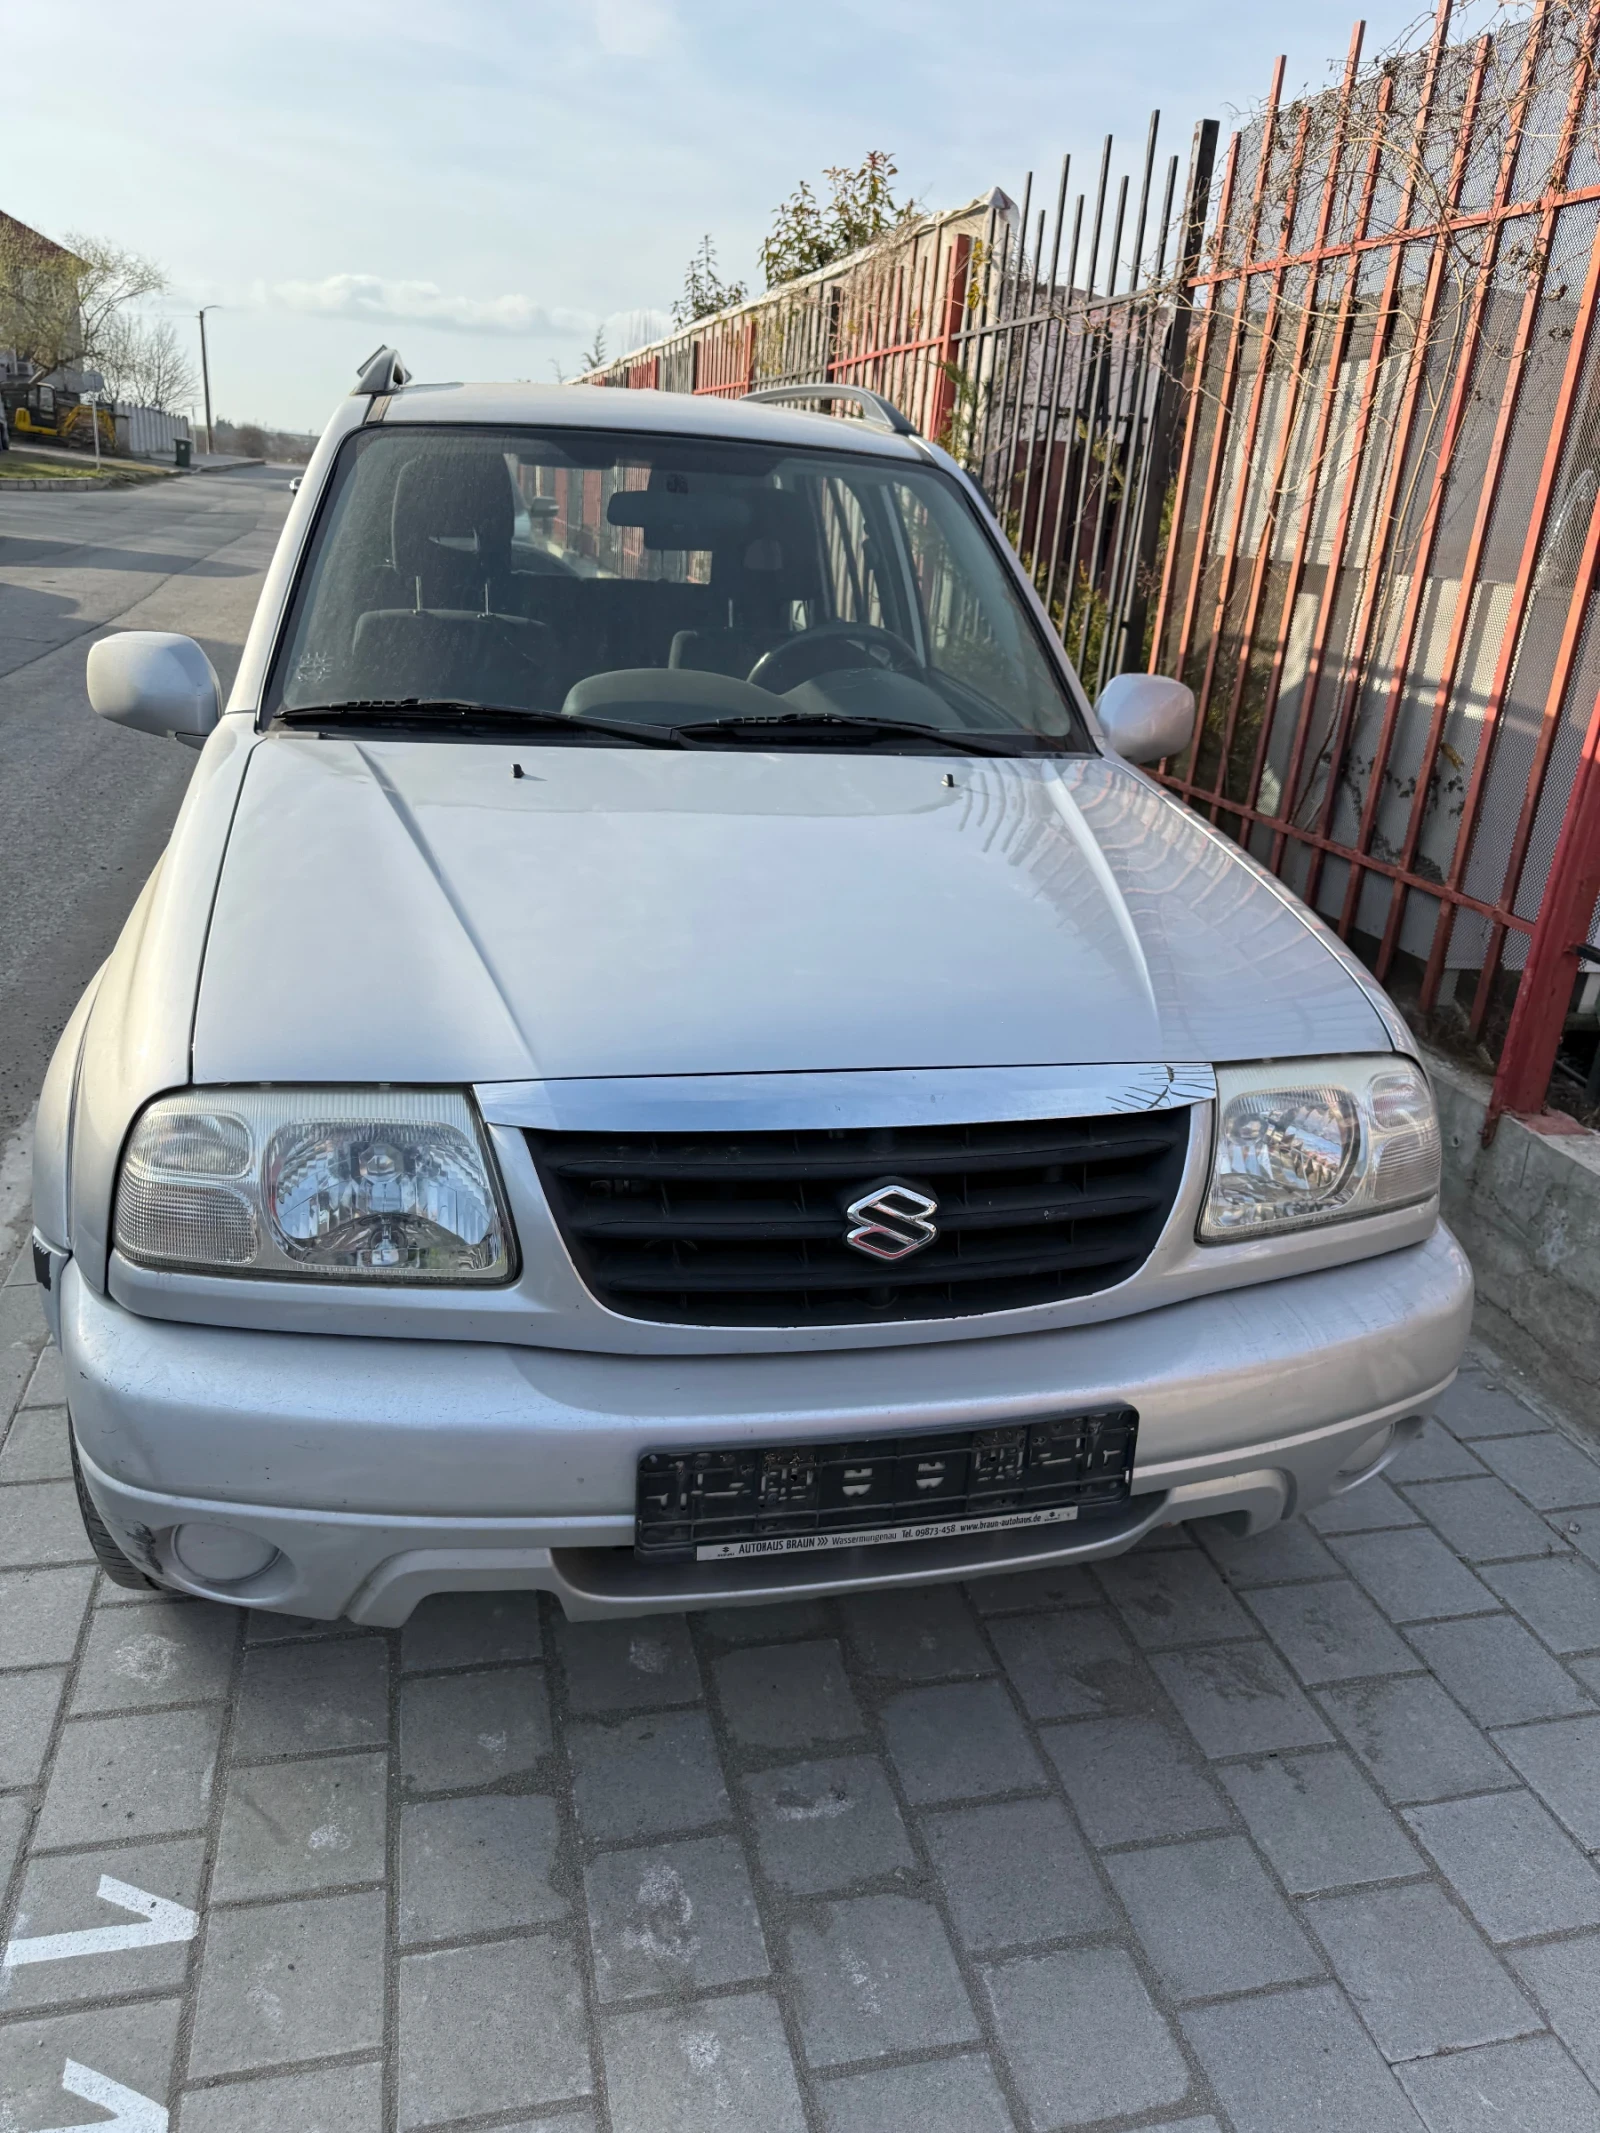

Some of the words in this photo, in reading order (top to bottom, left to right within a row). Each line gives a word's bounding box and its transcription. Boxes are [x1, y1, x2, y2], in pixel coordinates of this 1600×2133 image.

[738, 1540, 784, 1554] AUTOHAUS
[786, 1537, 815, 1549] BRAUN
[902, 1529, 914, 1538] Tel.
[915, 1525, 956, 1538] 09873-458
[960, 1514, 1042, 1532] www.braun-autohaus.de
